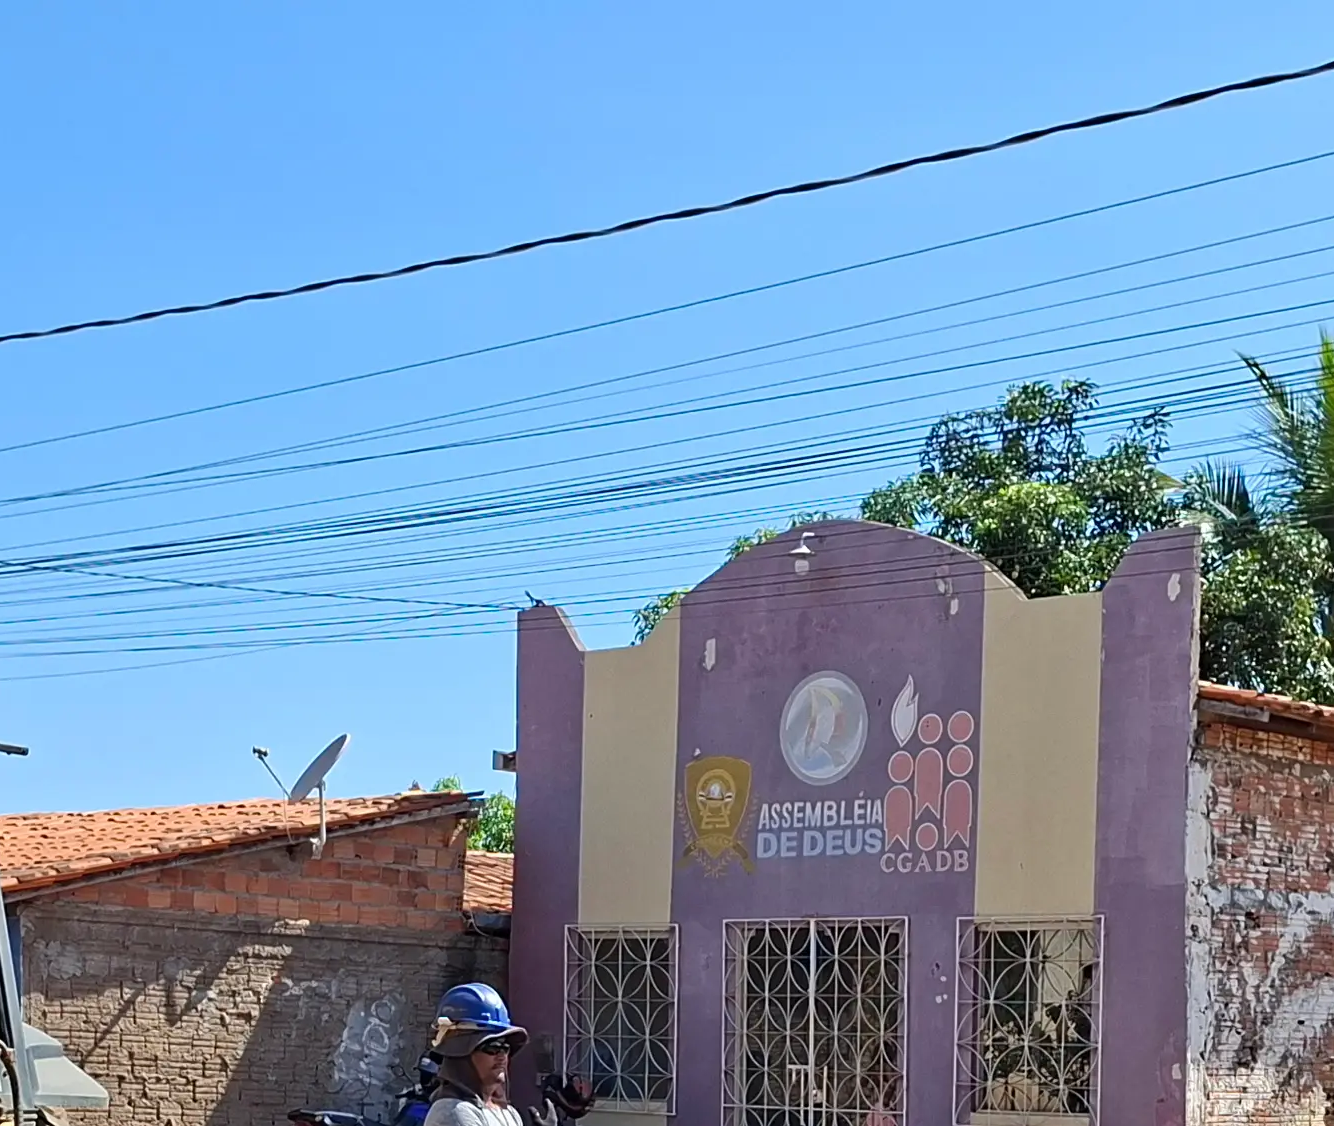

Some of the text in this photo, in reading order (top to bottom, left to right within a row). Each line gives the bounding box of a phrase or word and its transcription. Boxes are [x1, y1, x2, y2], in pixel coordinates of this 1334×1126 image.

[758, 790, 883, 830] ASSEMBLÉIA
[757, 829, 883, 859] DE DEUS
[880, 849, 970, 873] CGADB
